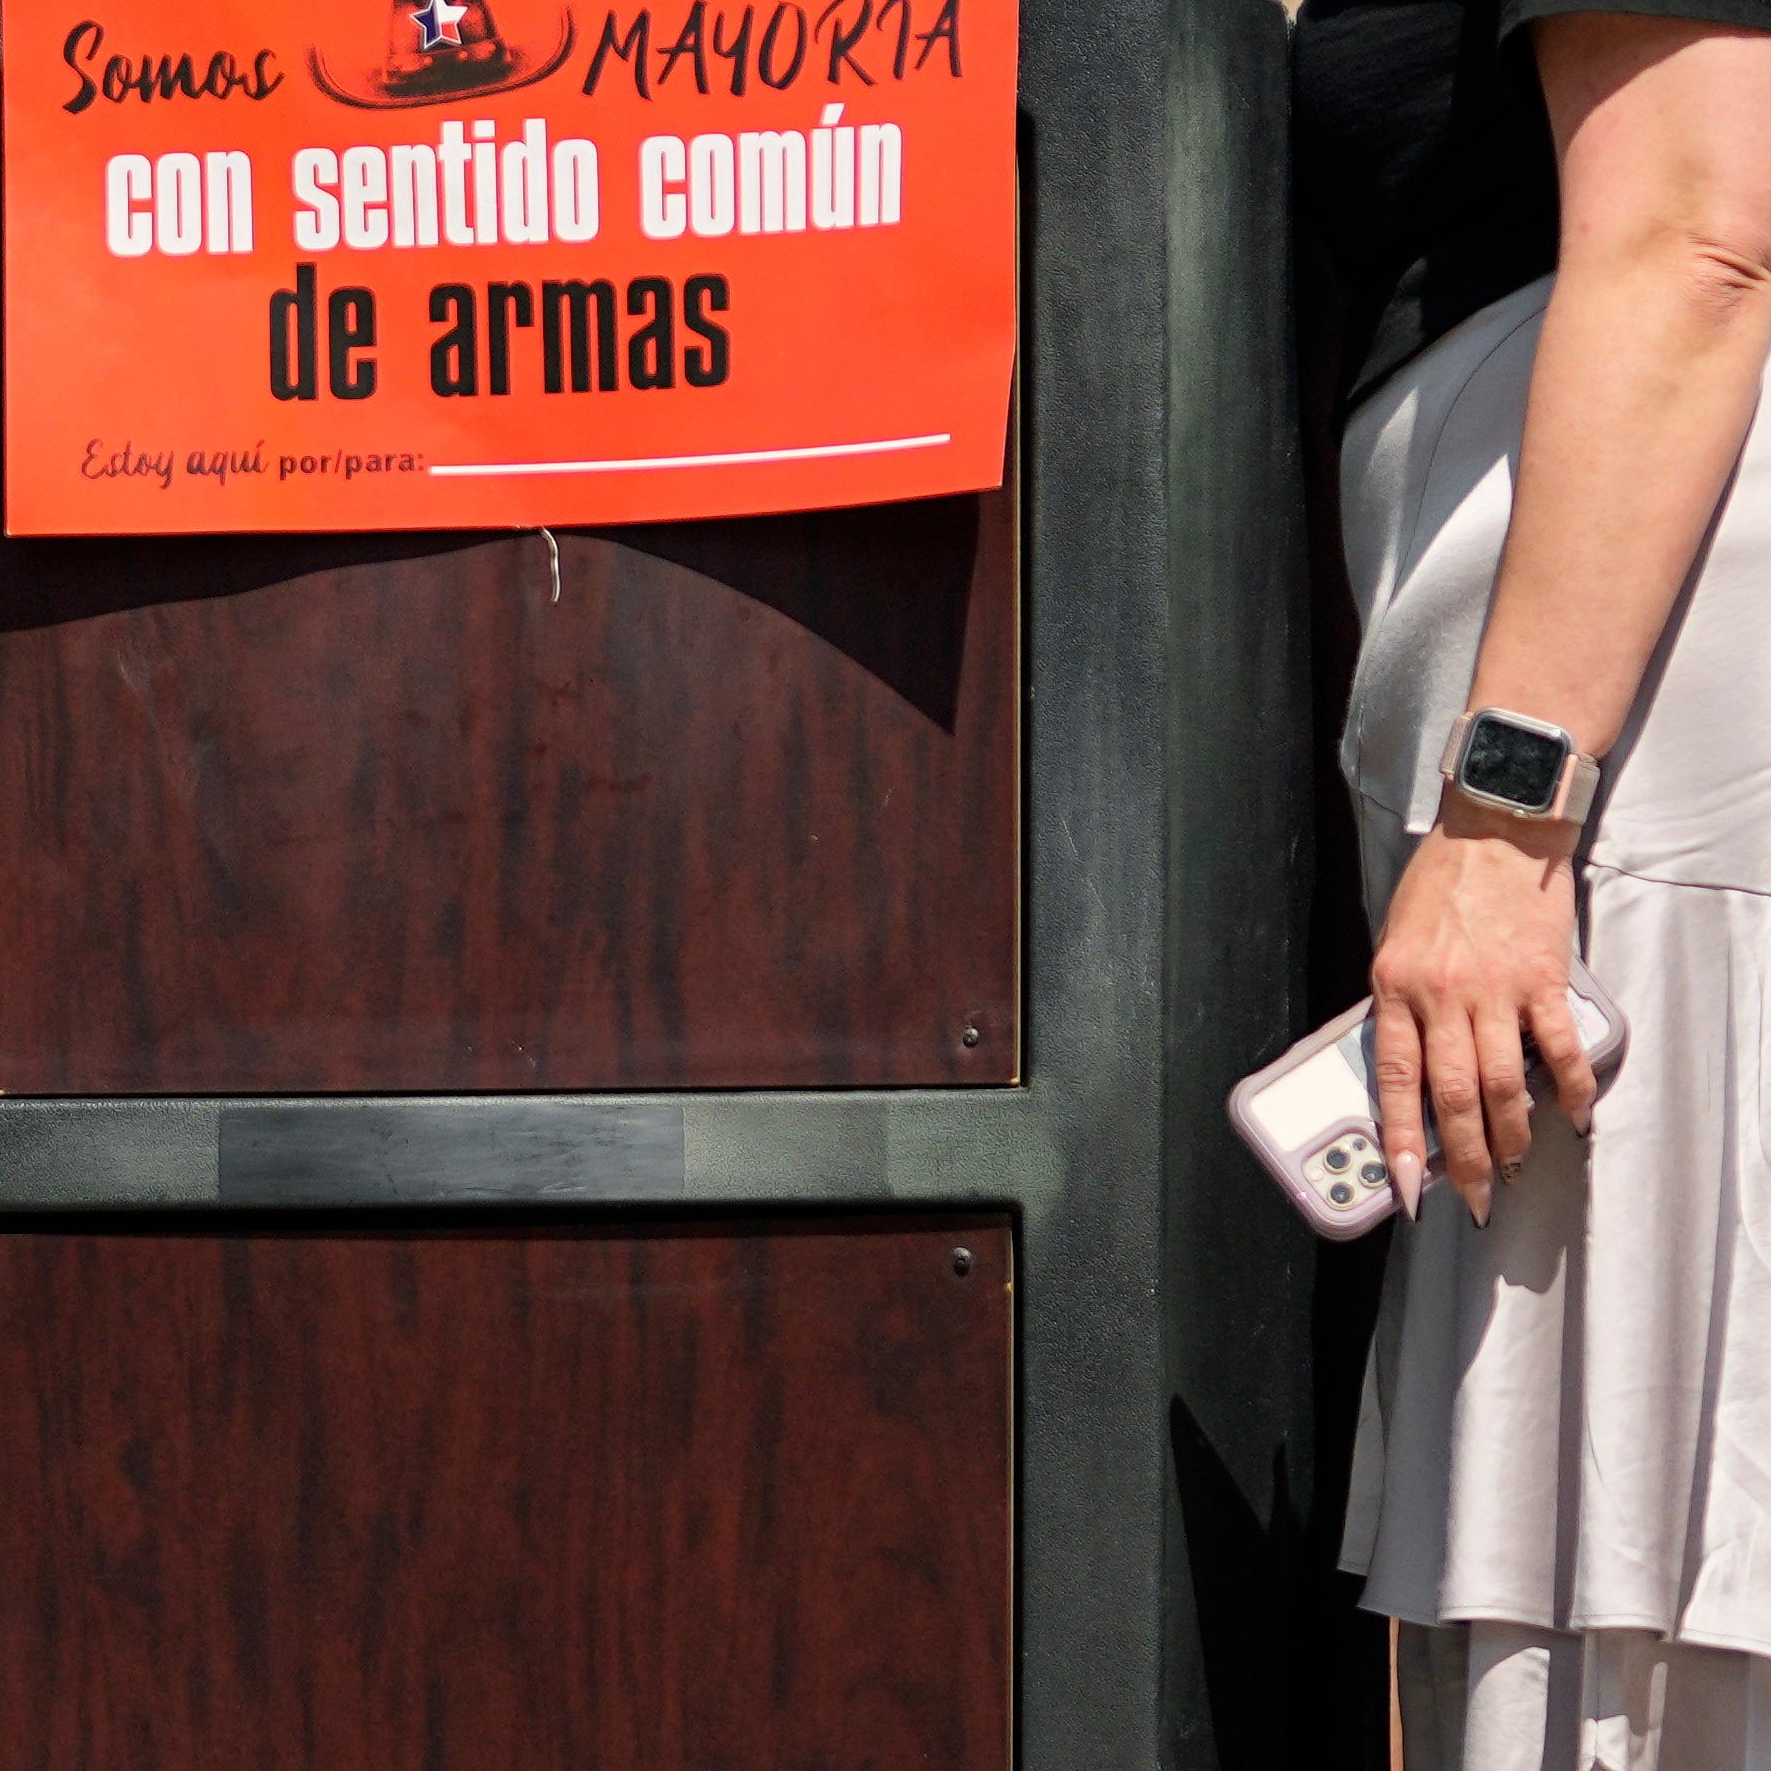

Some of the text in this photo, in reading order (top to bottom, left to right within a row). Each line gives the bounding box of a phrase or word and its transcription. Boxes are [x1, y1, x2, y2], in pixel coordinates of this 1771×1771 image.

[62, 20, 285, 115] Somos
[105, 104, 903, 257] con sentido común
[268, 261, 731, 401] de armas
[80, 435, 426, 491] Estoy aquí por/para:
